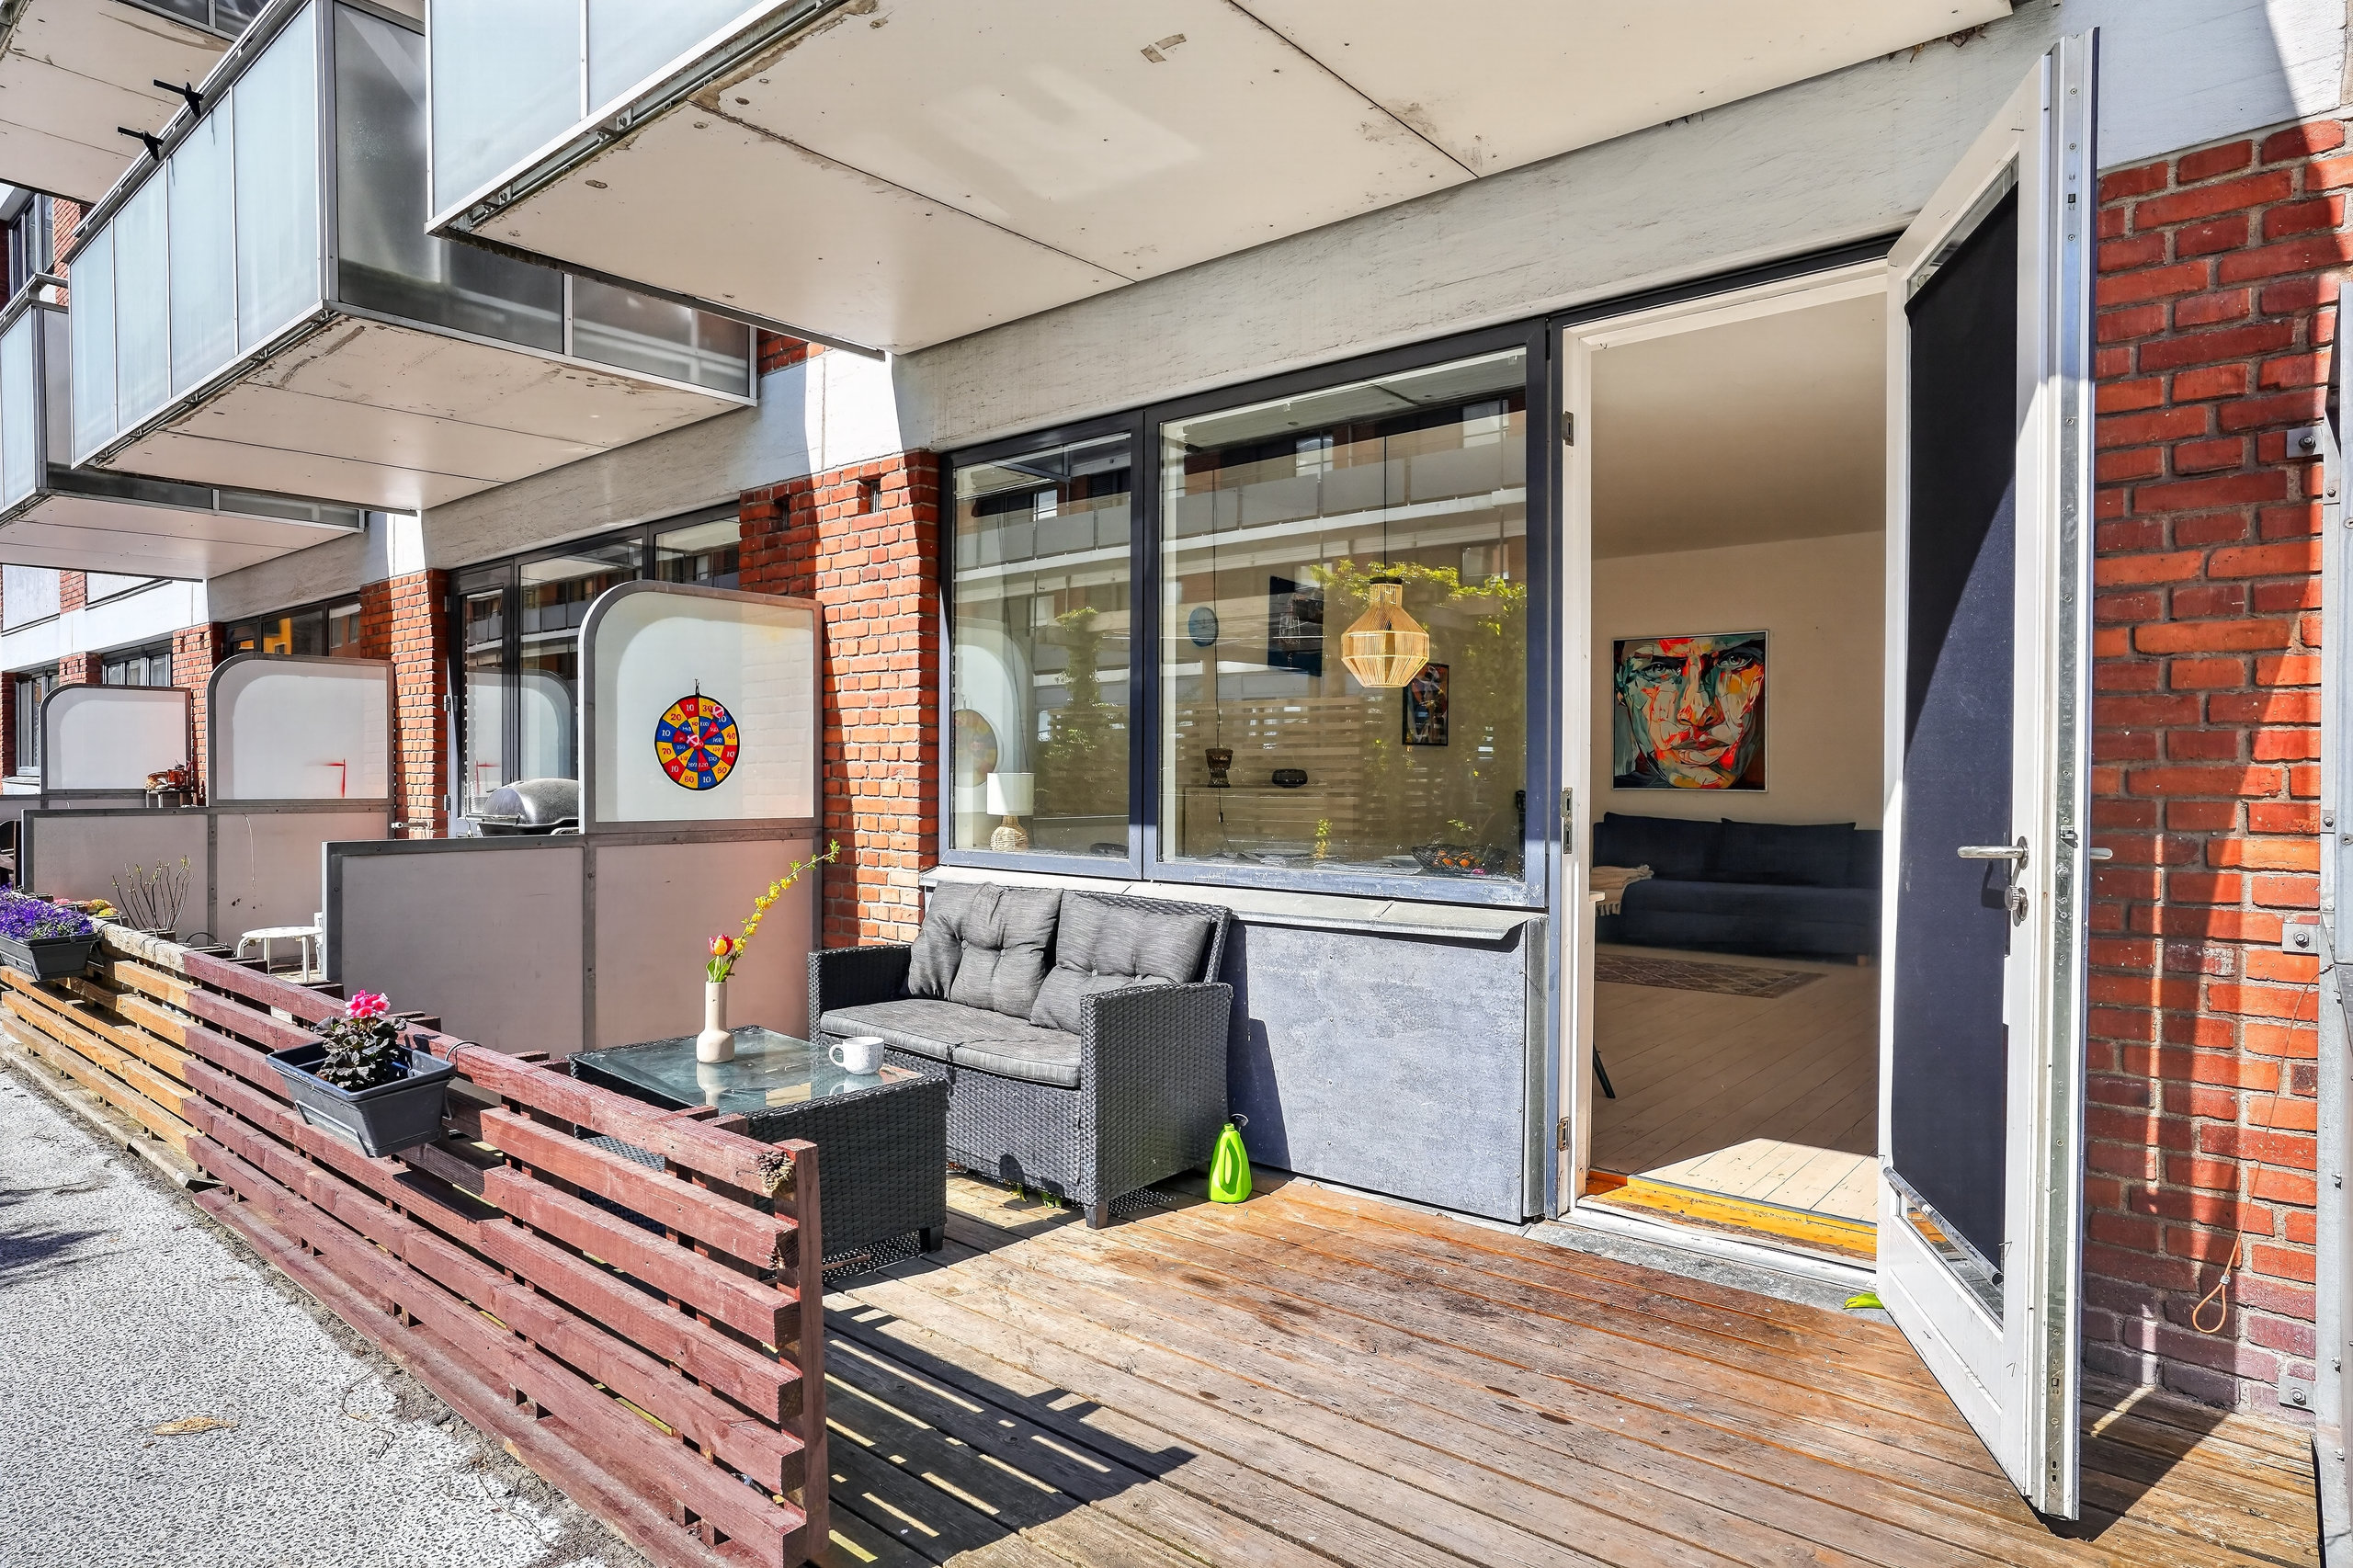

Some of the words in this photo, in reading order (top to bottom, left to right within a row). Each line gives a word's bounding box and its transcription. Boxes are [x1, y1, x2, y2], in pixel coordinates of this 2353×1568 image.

[702, 704, 713, 712] 30
[662, 729, 671, 737] 10
[726, 732, 735, 740] 40
[671, 765, 679, 773] 10
[684, 775, 695, 783] 60
